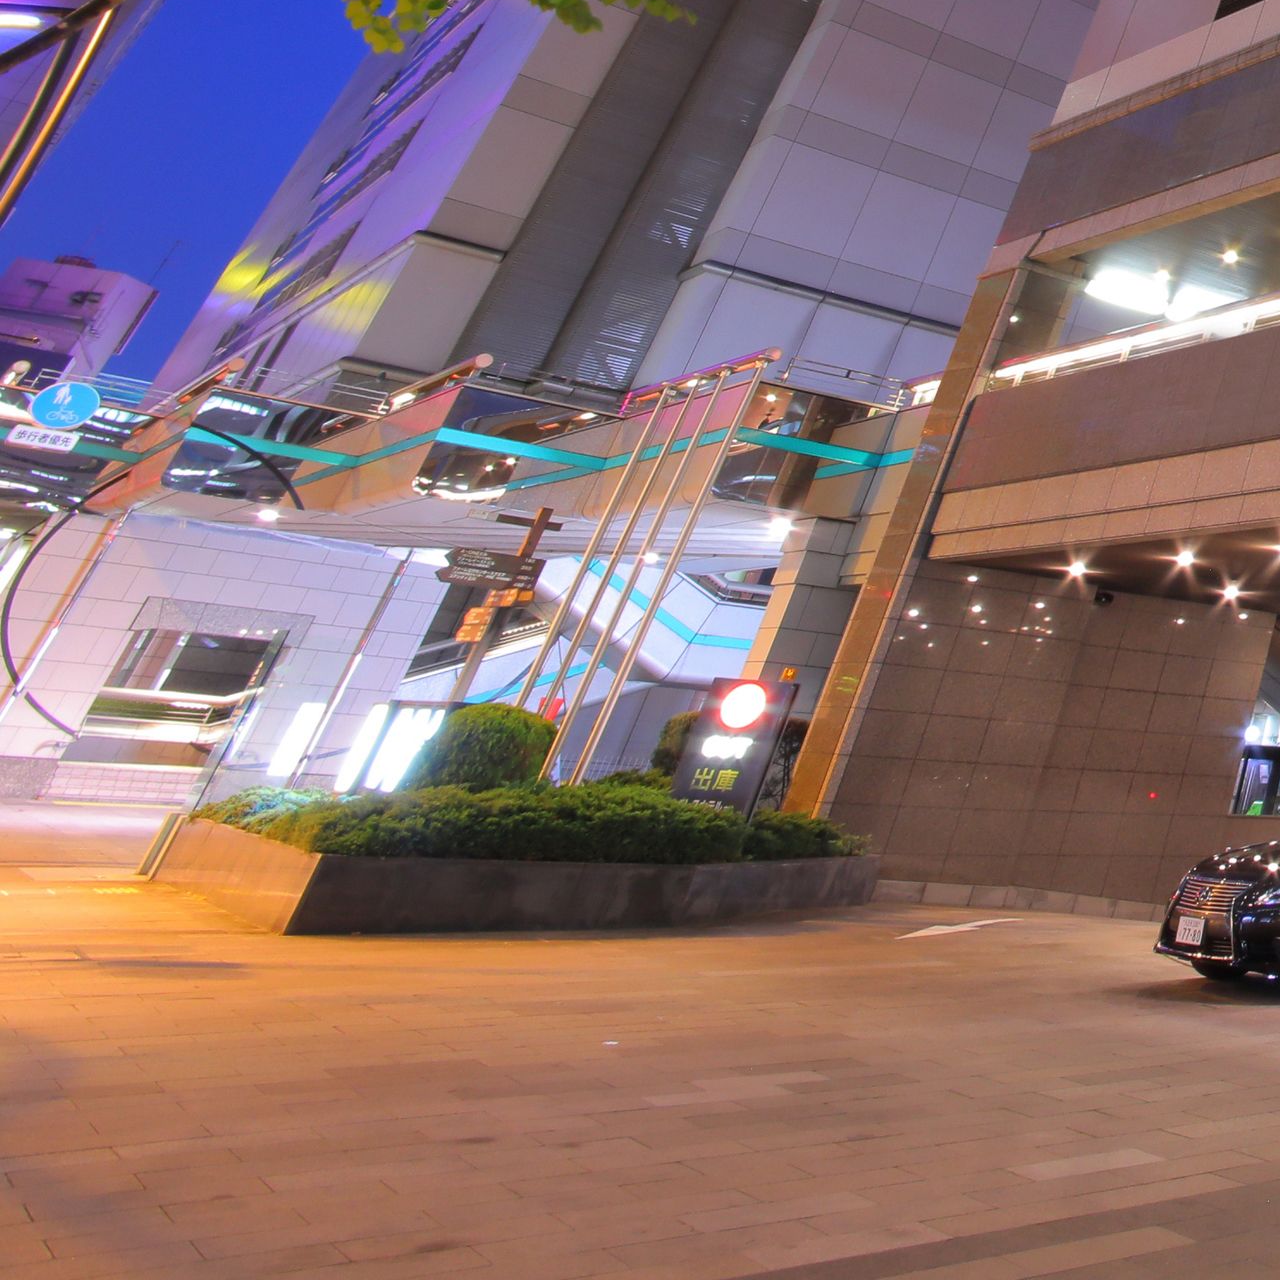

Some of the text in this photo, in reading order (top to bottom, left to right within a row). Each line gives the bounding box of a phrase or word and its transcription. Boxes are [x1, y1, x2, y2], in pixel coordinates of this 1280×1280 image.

[15, 430, 73, 447] 歩行者優先
[690, 767, 739, 792] 出庫
